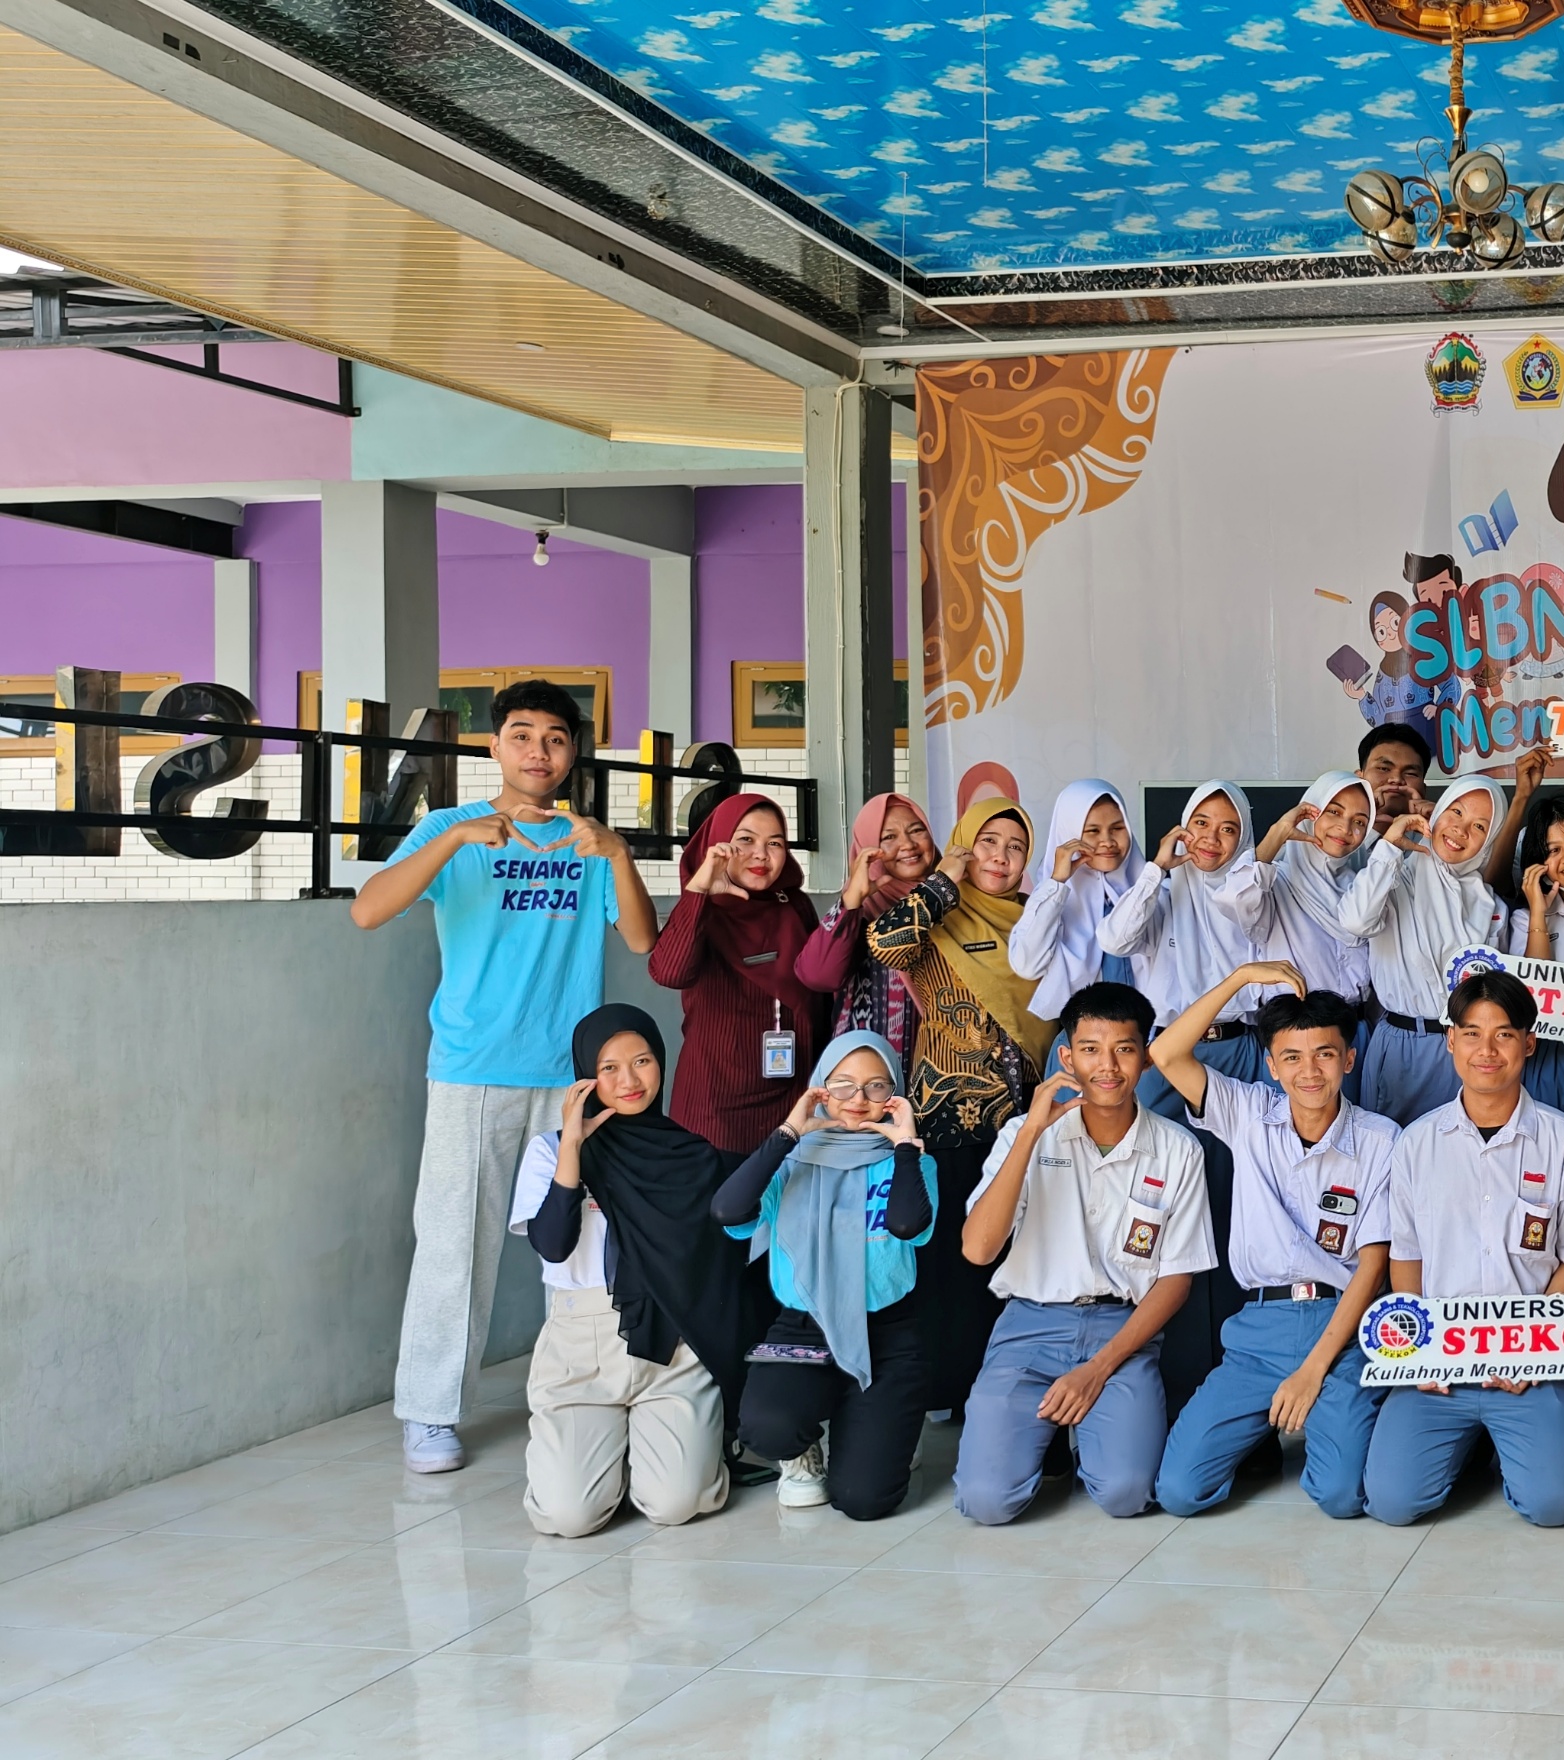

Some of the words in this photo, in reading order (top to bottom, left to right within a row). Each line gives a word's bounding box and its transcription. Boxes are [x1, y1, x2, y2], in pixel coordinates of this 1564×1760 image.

[492, 859, 583, 880] SENANG
[501, 889, 578, 911] KERJA
[1365, 1366, 1464, 1382] Kuliahnya
